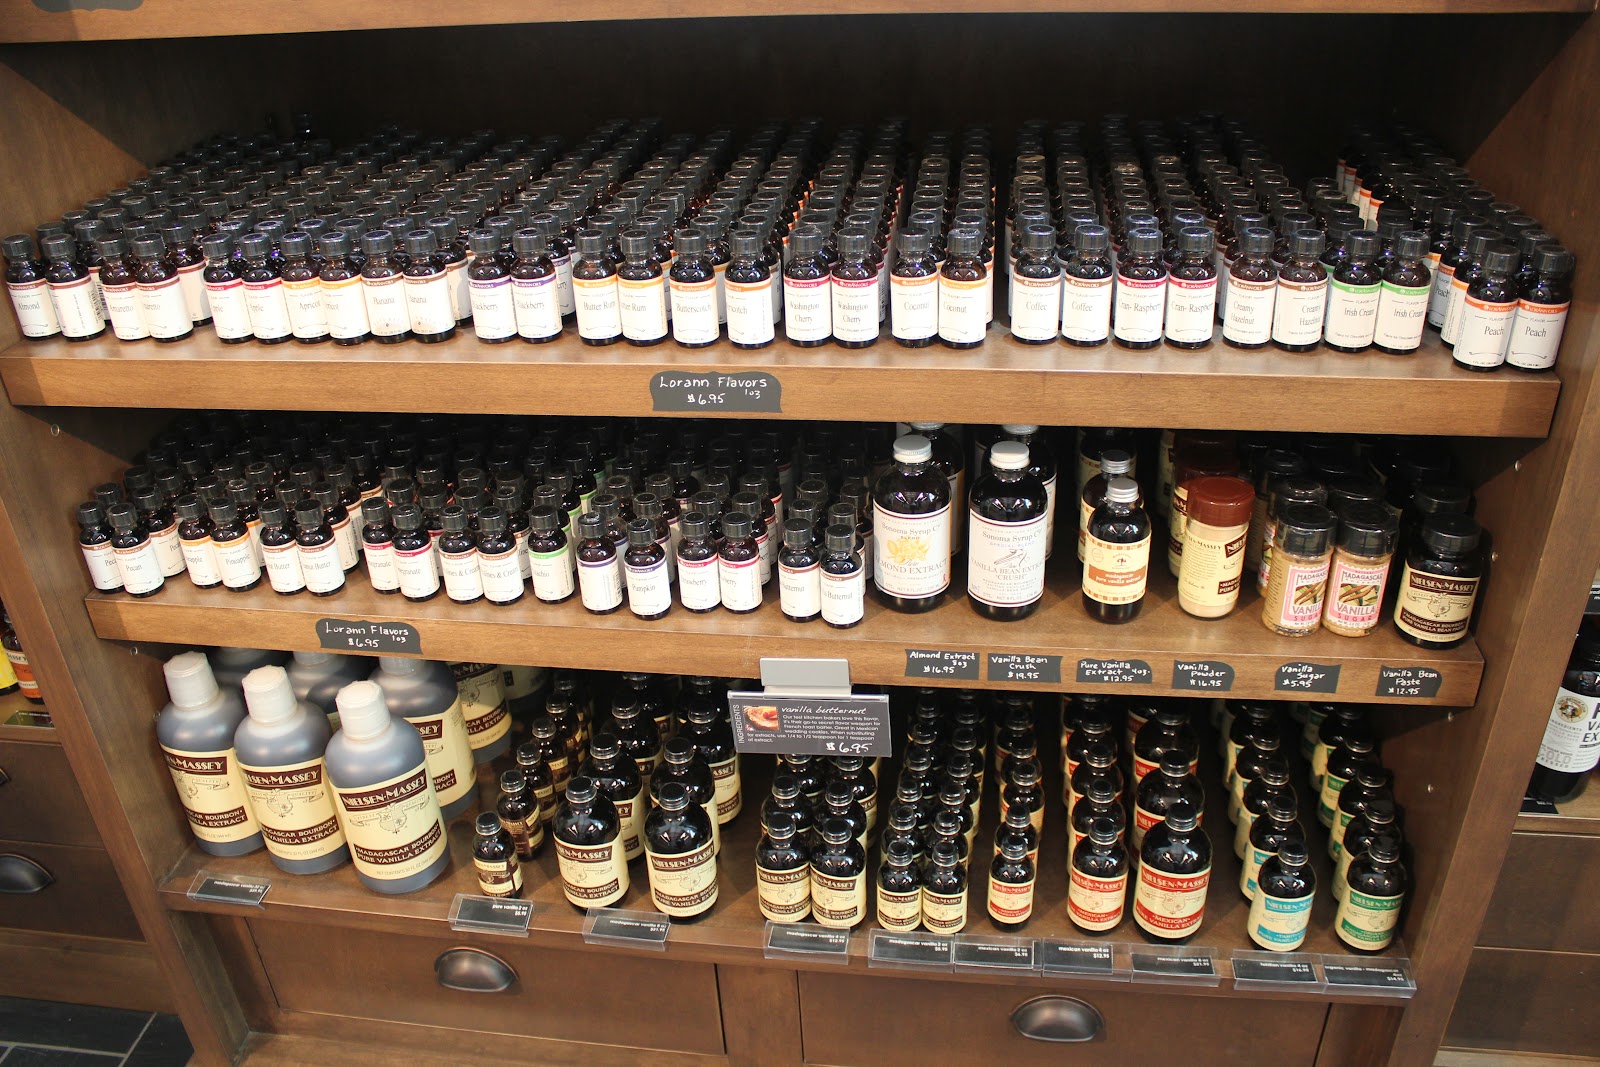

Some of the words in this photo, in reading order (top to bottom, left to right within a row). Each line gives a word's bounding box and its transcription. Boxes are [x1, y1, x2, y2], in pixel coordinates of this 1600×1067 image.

[299, 300, 320, 311] Apricot
[373, 296, 395, 305] Banana
[18, 302, 40, 310] Almond
[583, 301, 602, 311] Butter
[604, 301, 616, 309] Rum
[632, 304, 646, 312] Rum
[676, 303, 711, 313] Butterscotch
[790, 302, 820, 312] Washington
[837, 302, 869, 313] Washington
[904, 301, 930, 311] Coconut
[943, 301, 967, 313] Coconut
[1026, 301, 1047, 311] Coffee
[1072, 301, 1093, 312] Coffee
[1233, 301, 1254, 314] Creamy
[1345, 308, 1357, 316] Irish
[1394, 309, 1407, 317] Irish
[794, 315, 813, 324] Cherry
[842, 315, 861, 324] Cherry
[1231, 313, 1254, 325] Hazelnut
[1484, 326, 1504, 336] Peach
[1525, 326, 1546, 337] Peach
[660, 376, 710, 388] Lorann
[718, 376, 768, 388] Flavors
[687, 393, 726, 405] $6.95
[882, 522, 907, 534] Sonoma
[910, 527, 931, 535] Syrup
[982, 531, 1010, 542] Sonoma
[1012, 535, 1033, 543] Syrup
[225, 554, 250, 566] Pineapple
[126, 564, 142, 572] Pecan
[909, 558, 948, 574] EXTRACT
[1342, 570, 1383, 582] MADAGASCAR
[632, 584, 656, 594] Pumpkin
[827, 591, 853, 600] Butternut
[1336, 602, 1375, 615] VANILLA
[1338, 614, 1372, 622] SUGAR
[325, 622, 365, 634] Lorann
[370, 625, 409, 635] Flavors
[348, 638, 380, 647] $6.95
[910, 651, 941, 659] Almond
[1025, 656, 1048, 664] Bean
[1080, 661, 1098, 669] Pure
[1101, 661, 1131, 669] Vanilla
[1281, 664, 1313, 673] Vanilla
[1383, 669, 1412, 678] Vanilla
[1419, 670, 1437, 678] Bean
[1190, 679, 1222, 687] $16.95
[1282, 679, 1312, 688] $5.95
[1396, 678, 1421, 686] Paste
[1388, 687, 1420, 695] $12.95
[816, 706, 866, 714] butternut
[733, 704, 744, 743] INGREDIENTS
[826, 742, 872, 753] $6.95
[341, 775, 425, 806] NIELSEN-MASSEY
[205, 810, 240, 820] BOURBON
[209, 815, 246, 827] EXTRACT
[298, 820, 332, 837] BOURBON
[268, 833, 300, 844] VANILLA
[302, 825, 338, 843] EXTRACT
[357, 846, 409, 857] MADAGASCAR
[411, 824, 438, 849] BOURBON
[357, 853, 375, 863] PURE
[376, 853, 414, 864] VANILLA
[415, 831, 441, 854] EXTRACT
[587, 882, 614, 893] BOURBON
[589, 885, 618, 898] EXTRACT
[1150, 918, 1180, 928] VANILLA
[1155, 915, 1187, 923] MEXICAN
